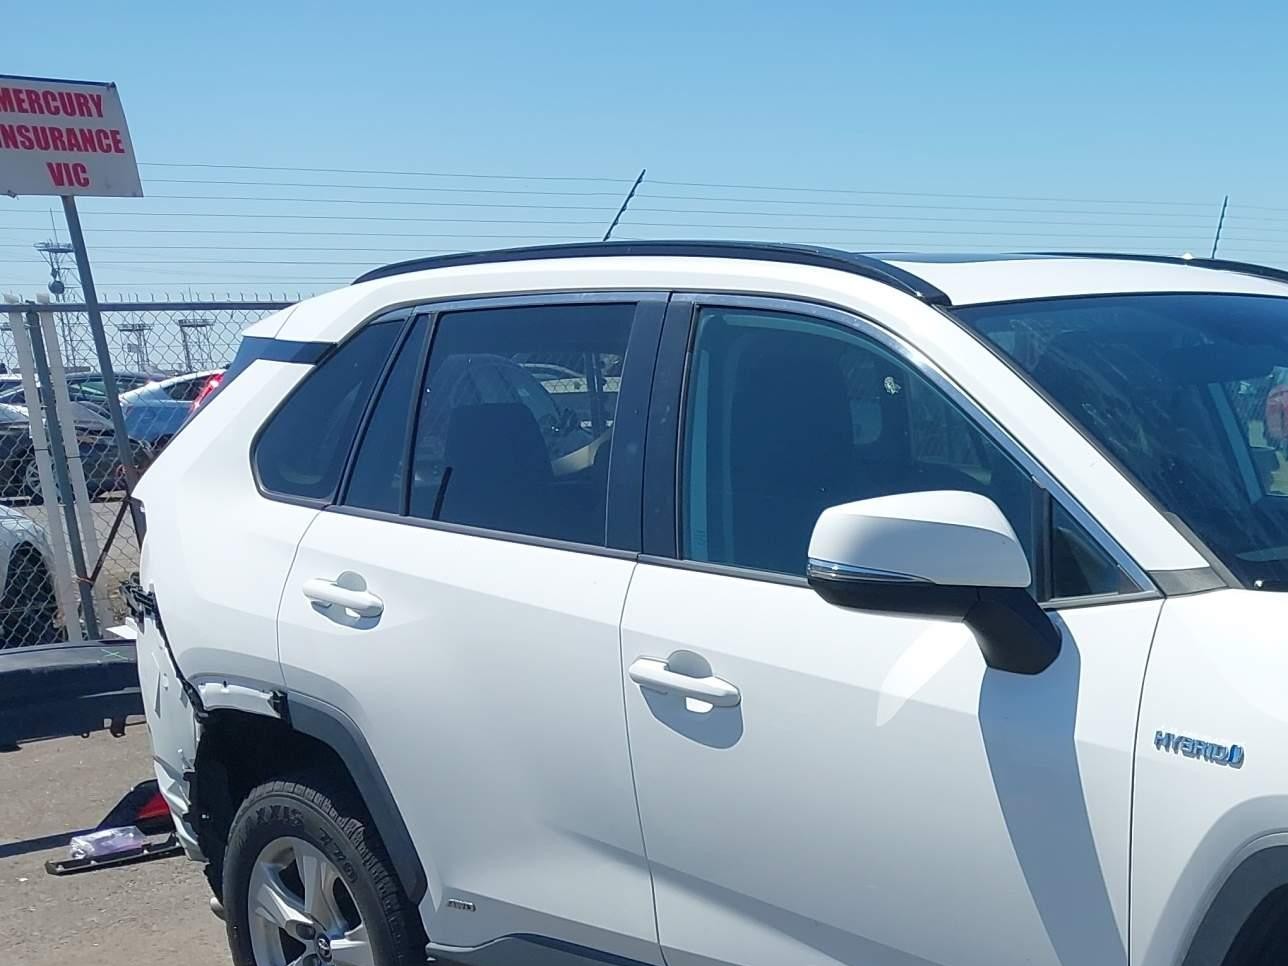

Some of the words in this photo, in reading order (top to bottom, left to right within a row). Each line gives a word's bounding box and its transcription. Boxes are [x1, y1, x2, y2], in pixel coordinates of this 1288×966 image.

[0, 88, 104, 118] MERCURY
[0, 124, 126, 154] NSURANCE
[46, 161, 90, 187] VIC
[1153, 730, 1229, 766] HYBRID
